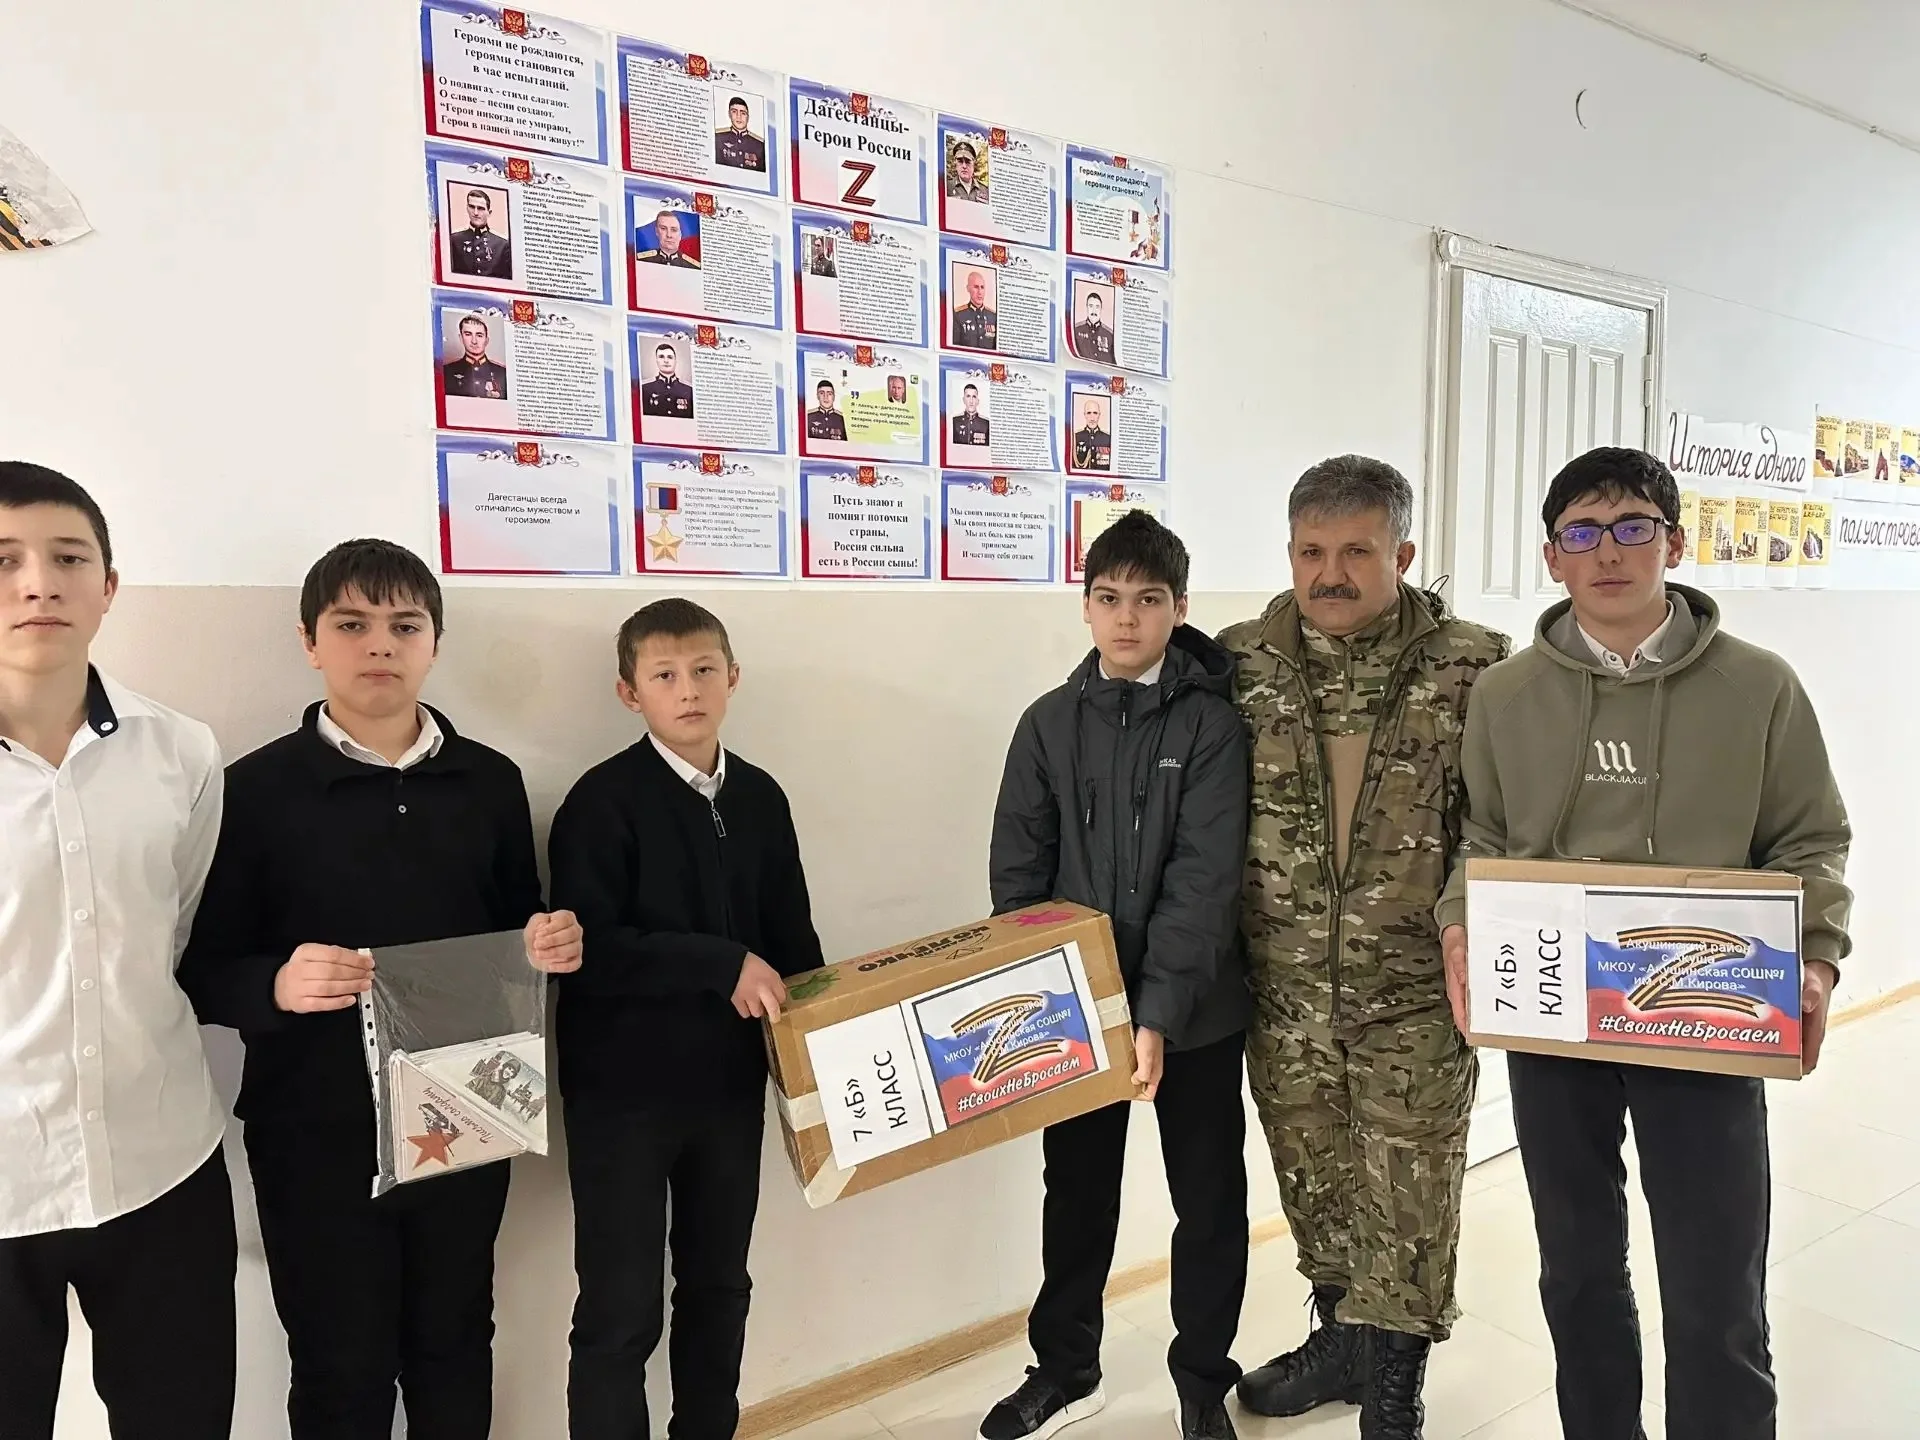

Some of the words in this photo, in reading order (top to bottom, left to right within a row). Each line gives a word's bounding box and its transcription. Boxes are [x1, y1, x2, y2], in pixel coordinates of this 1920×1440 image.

[454, 28, 502, 47] Героями
[506, 42, 518, 50] не
[521, 46, 584, 66] рождаются,
[465, 49, 511, 64] героями
[514, 59, 574, 77] становятся
[439, 76, 447, 85] О
[450, 80, 494, 94] подвигах
[502, 90, 528, 101] стихи
[531, 96, 569, 108] слагают.
[483, 68, 502, 78] час
[505, 72, 569, 91] испытаний.
[439, 89, 448, 98] О
[450, 93, 477, 103] славе
[488, 100, 514, 110] песни
[517, 106, 554, 118] создают.
[440, 102, 474, 116] “Герои
[477, 110, 514, 123] никогда
[441, 115, 469, 127] Герои
[481, 124, 510, 135] нашей
[513, 130, 546, 141] памяти
[804, 124, 851, 148] Герои
[858, 135, 911, 161] России
[1670, 412, 1752, 478] История
[1754, 425, 1806, 482] одного
[488, 493, 538, 503] Дагестанцы
[833, 495, 863, 507] Пусть
[868, 514, 908, 523] потомки
[834, 541, 867, 551] Россия
[850, 529, 888, 539] страны,
[852, 557, 885, 567] России
[888, 558, 918, 567] сыны!
[1626, 938, 1707, 952] Акушинский
[1495, 944, 1516, 989] «Б»
[1538, 928, 1562, 1015] КЛАСС
[1598, 961, 1636, 972] МКОУ
[1639, 963, 1728, 978] «Акушинская
[1731, 967, 1784, 980] СОШ№1
[1496, 998, 1517, 1012] 7
[944, 1045, 972, 1064] МКОУ
[1037, 1008, 1071, 1029] СОШ№1
[1598, 1016, 1781, 1044] #СвоихНеБросаем
[874, 1050, 908, 1128] КЛАСС
[957, 1056, 1080, 1112] #СвоихНеБросаем
[845, 1078, 866, 1118] «Б»
[853, 1130, 872, 1142] 7
